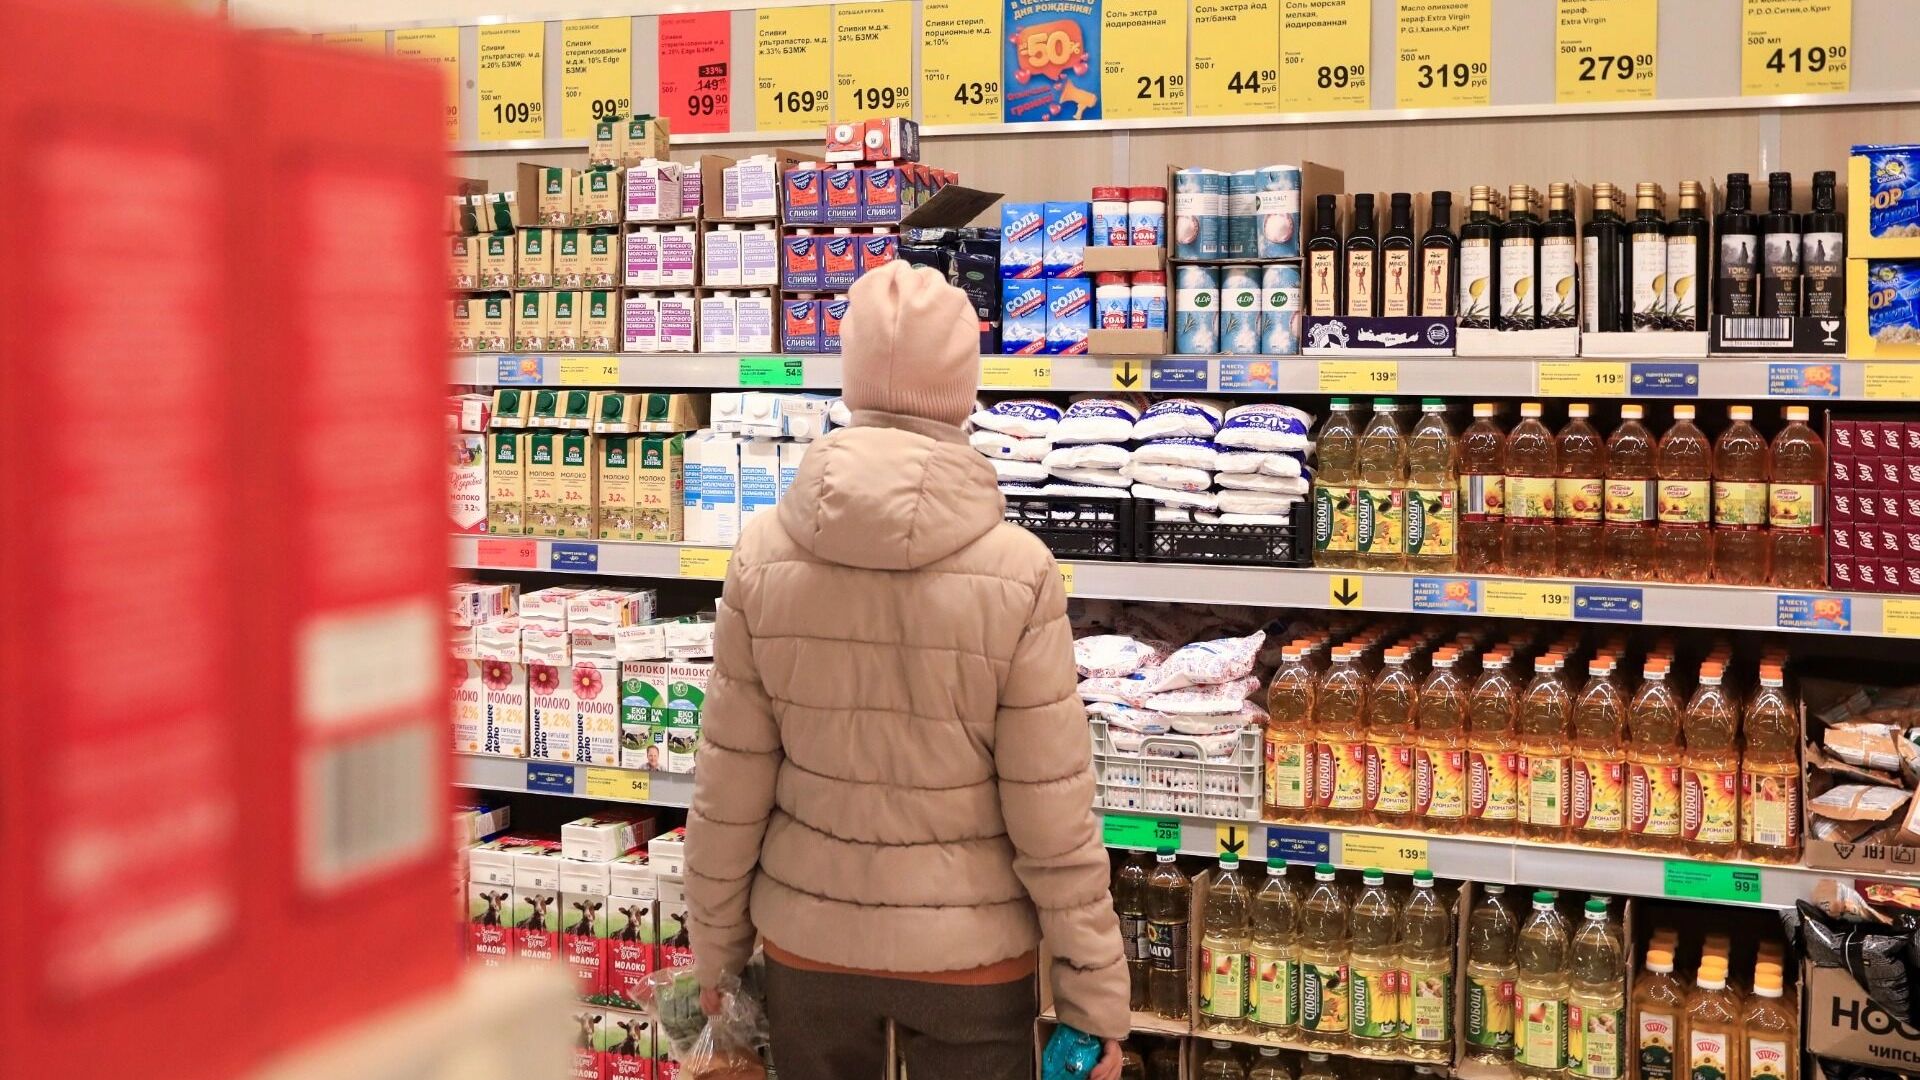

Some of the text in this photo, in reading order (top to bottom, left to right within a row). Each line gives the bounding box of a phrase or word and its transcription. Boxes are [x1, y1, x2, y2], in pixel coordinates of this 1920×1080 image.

[1195, 2, 1267, 14] Соль экстра йод
[1285, 0, 1346, 9] Соль морская
[1401, 2, 1469, 12] Масло оливковое
[1014, 3, 1093, 20] ДНЯ РОЖДЕНИЯ!
[1106, 9, 1158, 18] Соль экстра
[1195, 14, 1237, 24] пэт/банка
[1448, 13, 1470, 22] Virgin
[1583, 17, 1606, 25] Virgin
[925, 19, 955, 28] Сливки
[1105, 18, 1167, 28] йодированная
[1285, 19, 1347, 29] йодированная
[759, 29, 787, 37] Сливки
[838, 25, 867, 33] Сливки
[925, 28, 975, 38] порционные
[838, 33, 879, 42] 34% БЗМЖ
[1748, 37, 1765, 45] 500
[481, 44, 505, 52] Сливки
[565, 39, 592, 47] Сливки
[565, 46, 627, 56] стерилизованные
[783, 46, 807, 55] БЗМЖ
[1561, 46, 1576, 54] 500
[588, 56, 602, 64] 10%
[603, 56, 620, 65] Edge
[1285, 56, 1299, 64] 500
[1400, 54, 1416, 62] 500
[1766, 46, 1847, 73] 419 90 руб
[565, 66, 587, 75] БЗМЖ
[701, 67, 723, 75] -33%
[1105, 66, 1119, 74] 500
[1195, 62, 1209, 70] 500
[1579, 54, 1653, 81] 279 90 руб
[1317, 65, 1366, 89] 89 90 руб
[1417, 62, 1488, 88] 319 90 руб
[698, 80, 718, 91] 149
[759, 81, 771, 89] 500
[838, 78, 851, 86] 500
[1228, 69, 1277, 94] 44 90 руб
[1137, 75, 1184, 99] 21 90 руб
[565, 90, 577, 98] 500
[853, 87, 910, 110] 199 90 руб
[954, 82, 999, 105] 43 90 руб
[688, 94, 728, 116] 99 90 руб
[774, 90, 829, 113] 169 90 руб
[493, 102, 542, 124] 109 90 руб
[591, 98, 629, 120] 99 90
[789, 209, 818, 217] СЛИВКИ
[866, 208, 896, 216] СЛИВКИ
[1004, 212, 1040, 237] СОЛЬ
[1047, 210, 1084, 236] СОЛЬ
[1133, 232, 1155, 240] СОЛЬ
[787, 276, 817, 284] СЛИВКИ
[1006, 288, 1041, 312] СОЛЬ
[602, 366, 613, 374] 74
[785, 369, 796, 377] 54
[1033, 369, 1045, 377] 15
[1370, 372, 1389, 381] 139
[1596, 374, 1616, 384] 119
[1235, 415, 1291, 431] СОЛЬ
[498, 488, 514, 497] 3,2%
[609, 493, 626, 502] 3,2%
[1316, 497, 1327, 541] СЛОБОДА
[1408, 500, 1418, 545] СЛОБОДА
[520, 549, 530, 557] 59
[1541, 594, 1562, 604] 139
[624, 664, 665, 675] МОЛОКО
[487, 692, 523, 706] МОЛОКО
[577, 701, 614, 715] МОЛОКО
[485, 704, 494, 752] Хорошее
[493, 726, 501, 754] дело
[1319, 753, 1330, 798] СЛОБОДА
[632, 781, 642, 790] 54
[1418, 759, 1427, 806] СЛОБОДА
[1632, 775, 1644, 824] СЛОБОДА
[1788, 786, 1797, 837] СЛОБОДА
[1154, 829, 1172, 839] 129
[1398, 849, 1419, 859] 139
[1735, 881, 1750, 892] 99
[569, 955, 600, 967] МОЛОКО
[615, 960, 646, 972] МОЛОКО
[1355, 979, 1365, 1027] СЛОБОДА
[1471, 988, 1481, 1035] СЛОБОДА
[1645, 1022, 1668, 1034] VIVID
[1756, 1050, 1780, 1061] VIVID
